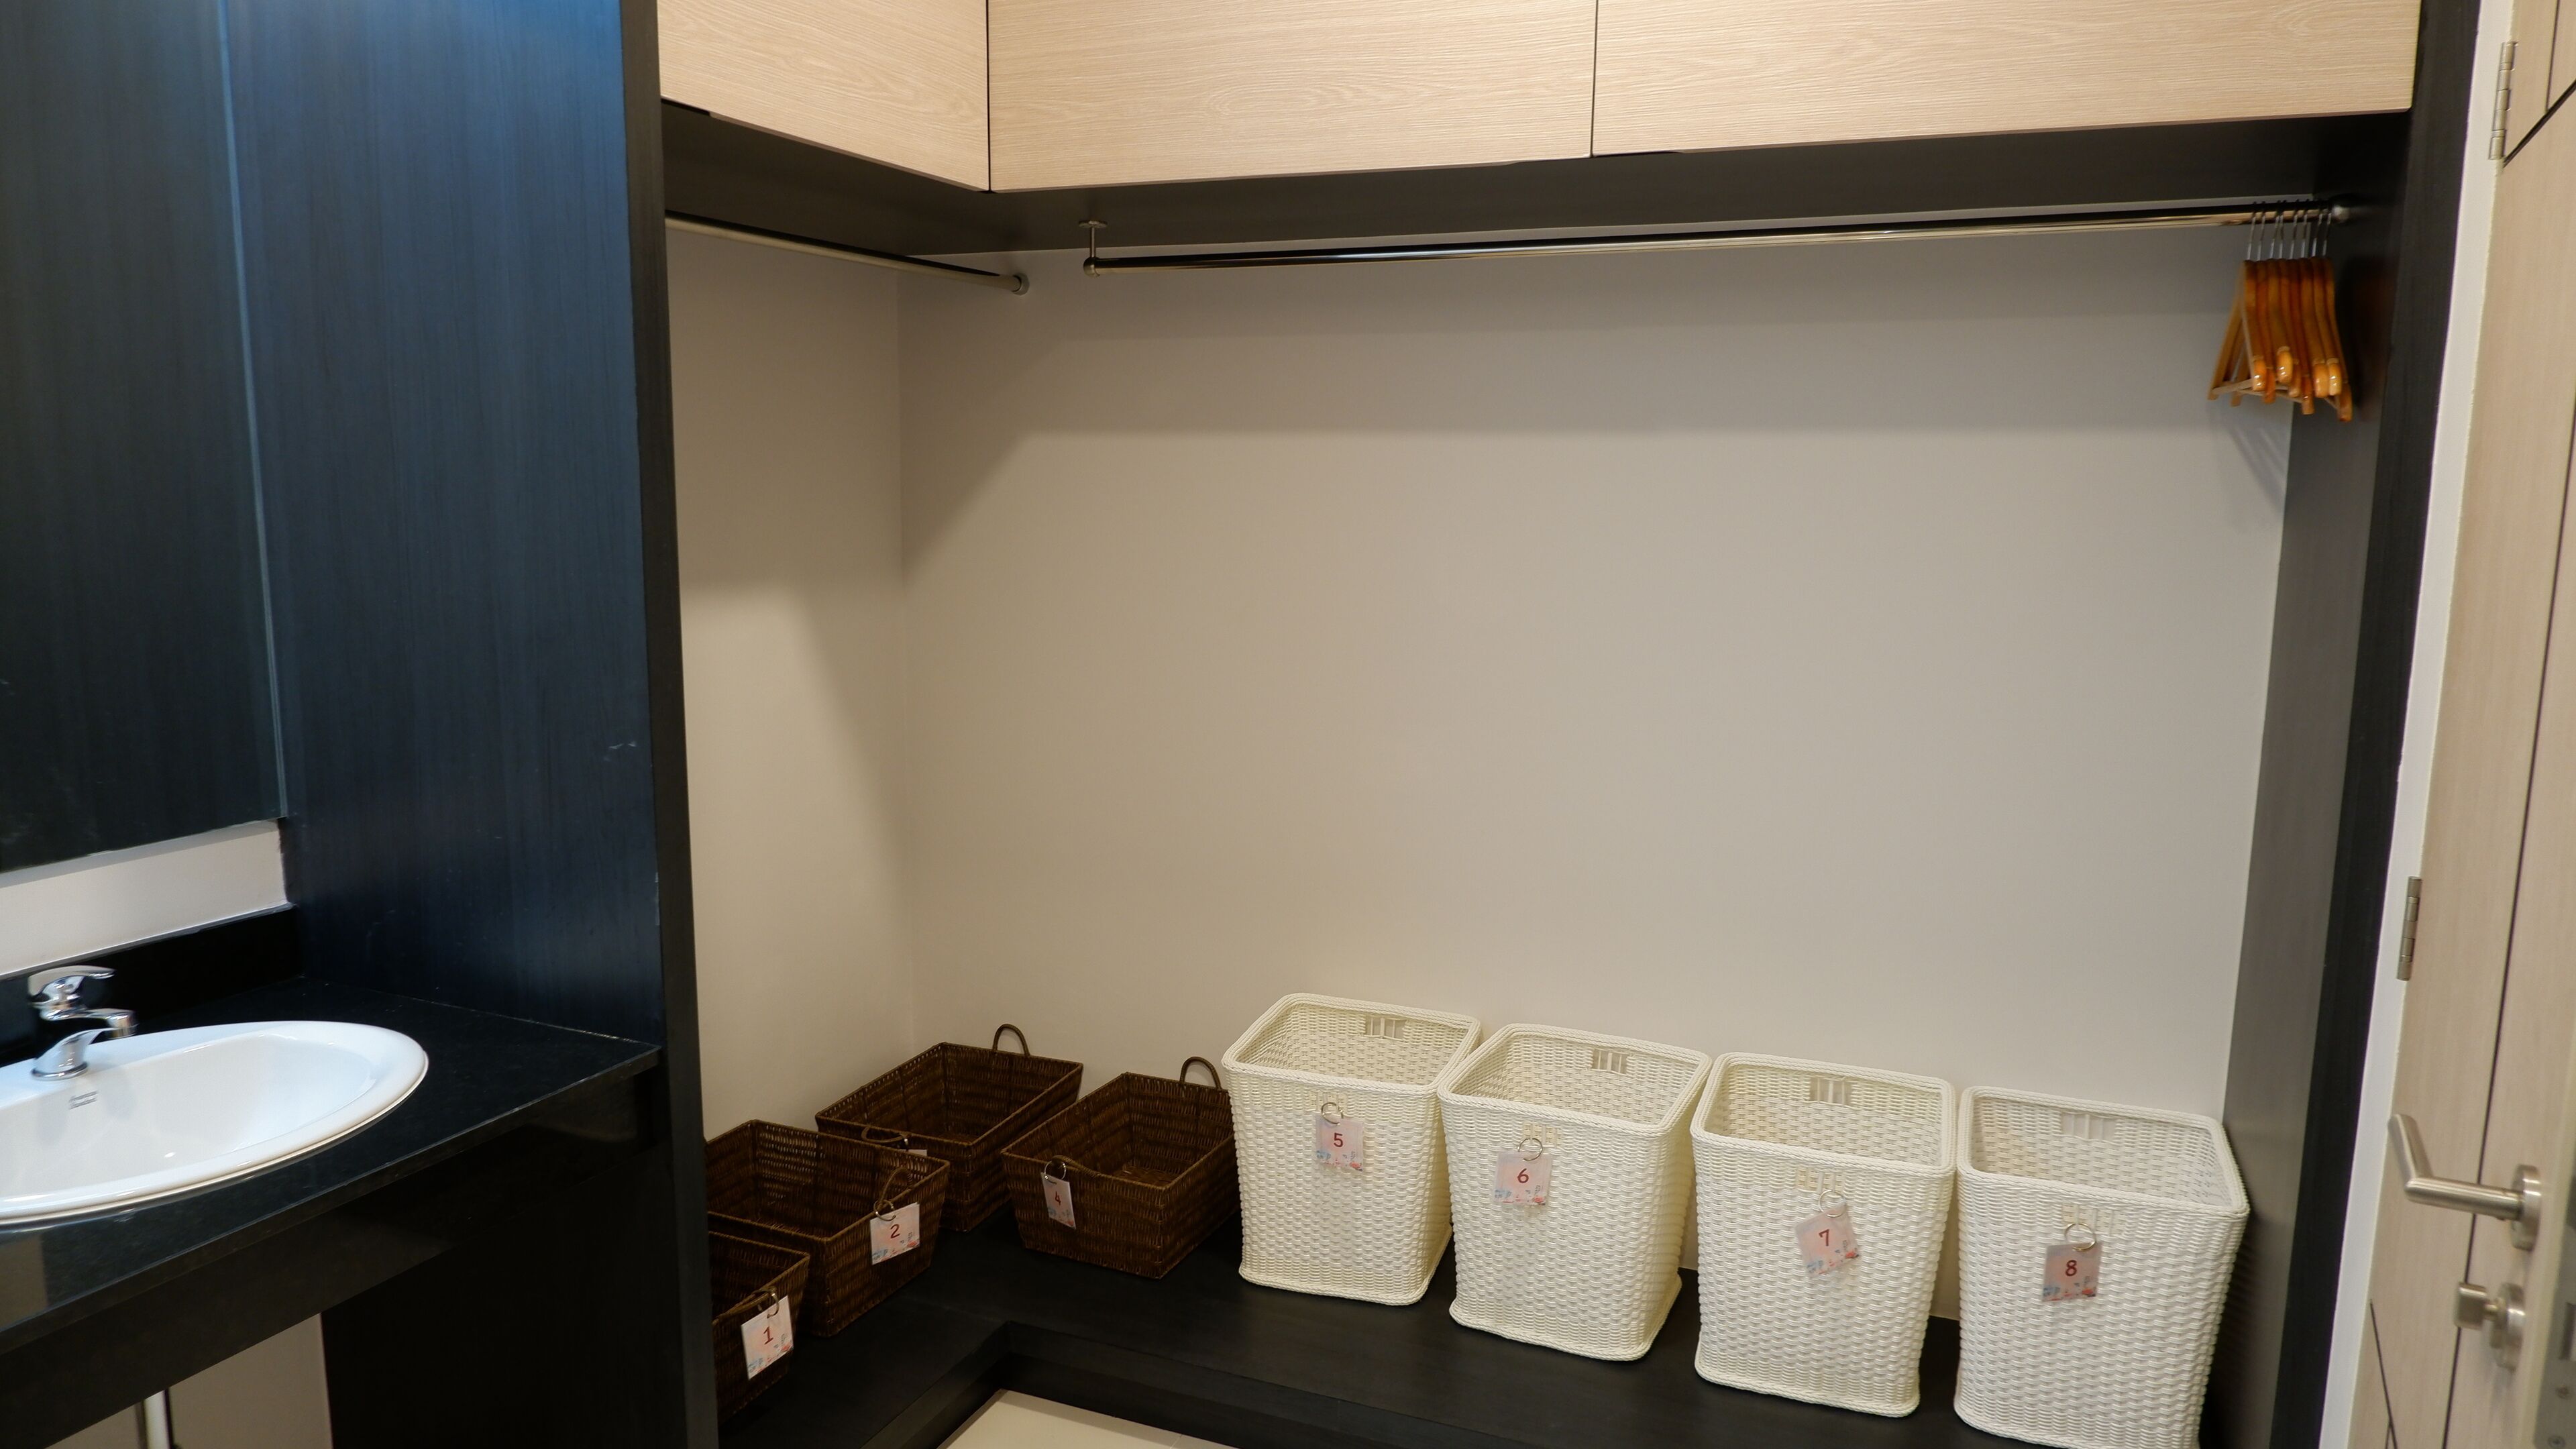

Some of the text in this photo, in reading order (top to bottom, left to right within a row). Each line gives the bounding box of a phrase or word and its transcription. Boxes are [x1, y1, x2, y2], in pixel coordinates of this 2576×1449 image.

[1334, 1132, 1344, 1148] 5
[1517, 1168, 1529, 1183] 6
[1054, 1190, 1062, 1206] 4
[890, 1224, 900, 1239] 2
[1819, 1229, 1829, 1246] 7
[2065, 1260, 2078, 1277] 8
[763, 1326, 773, 1345] 1
